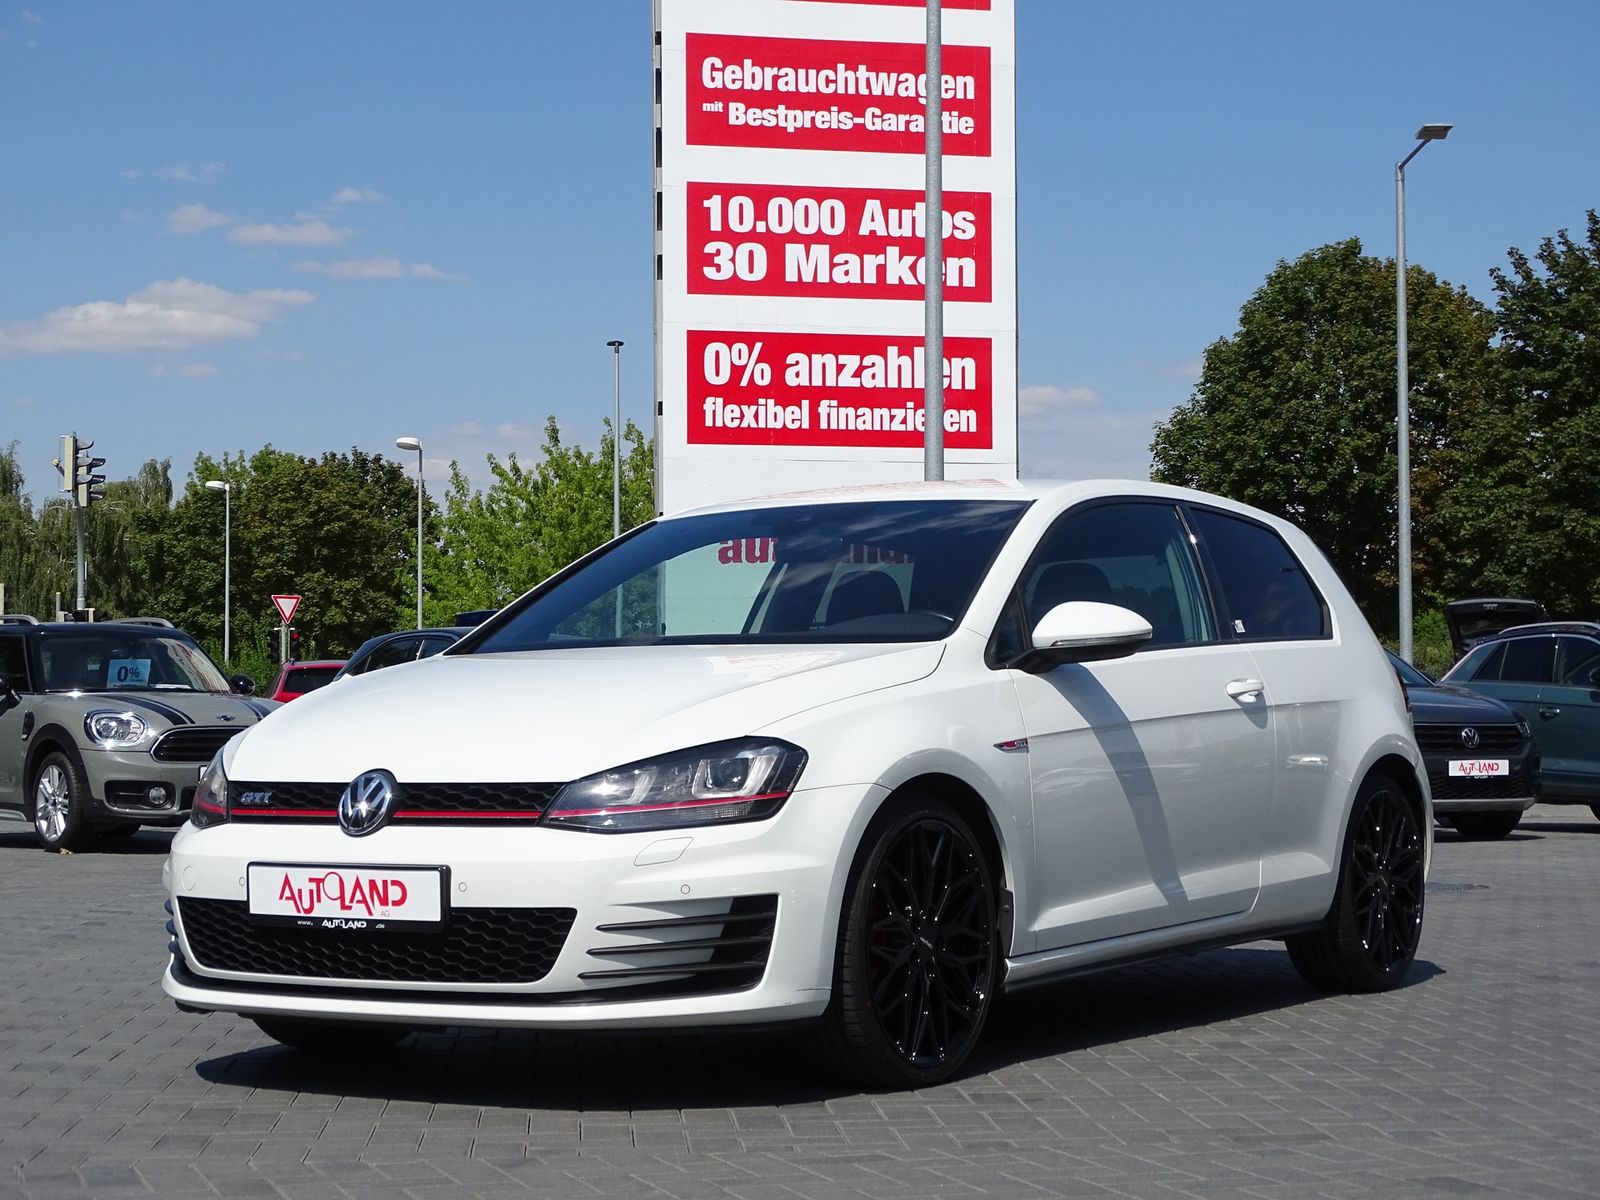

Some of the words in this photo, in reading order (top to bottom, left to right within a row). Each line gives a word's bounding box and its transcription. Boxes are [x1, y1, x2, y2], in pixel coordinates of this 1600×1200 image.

[702, 101, 723, 113] mit
[728, 102, 975, 135] Bestpreis-Garatie
[703, 194, 846, 236] 10.000
[703, 242, 768, 282] 30
[703, 342, 772, 387] 0%
[703, 397, 810, 430] flexibel
[817, 401, 977, 433] finanzieen
[117, 666, 140, 682] 0%
[278, 871, 408, 917] AUTOLAND
